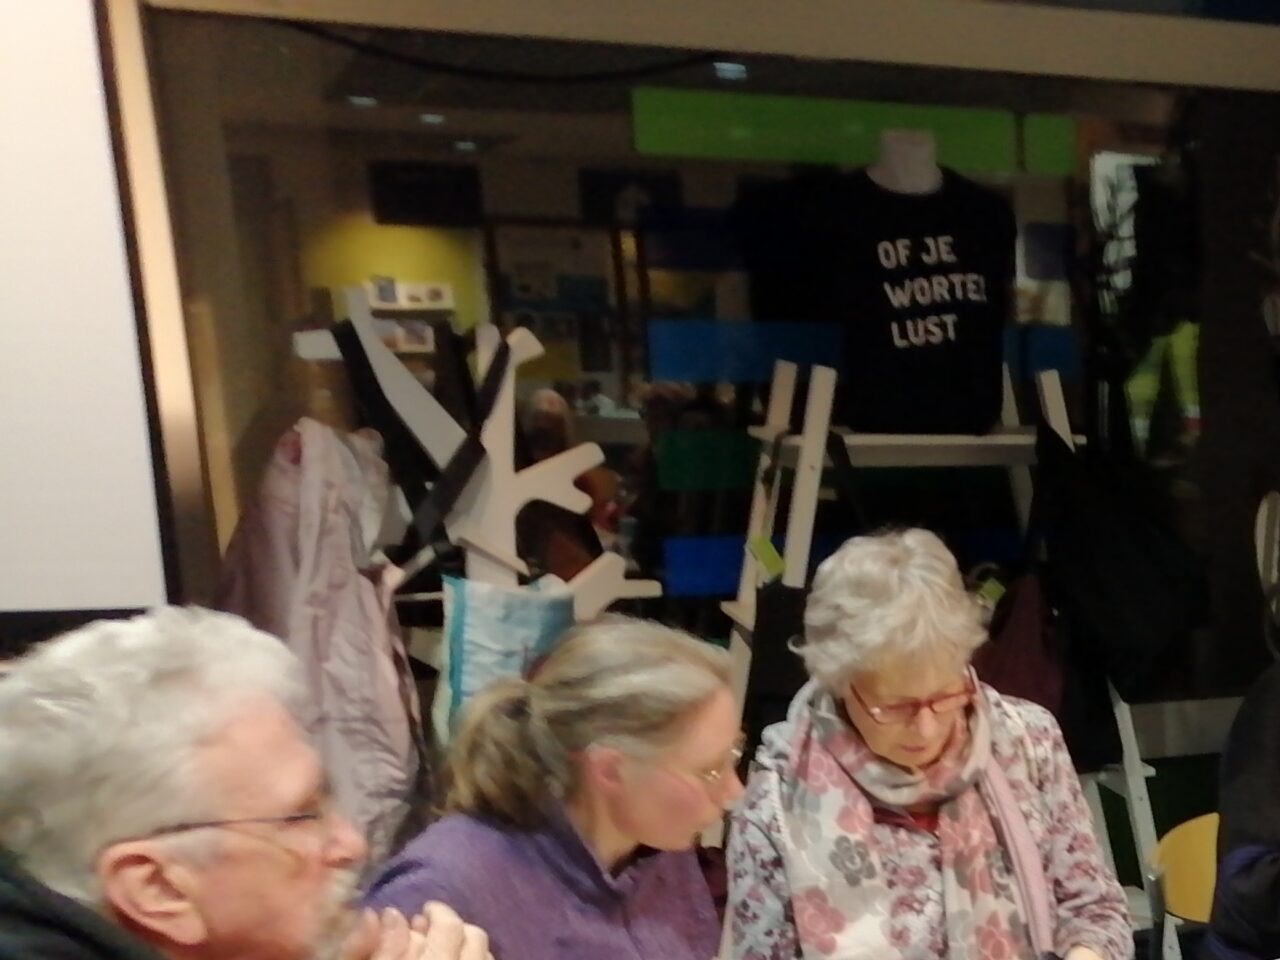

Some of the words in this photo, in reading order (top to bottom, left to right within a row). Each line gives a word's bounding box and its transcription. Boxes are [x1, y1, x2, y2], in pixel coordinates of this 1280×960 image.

[878, 239, 911, 269] OF
[921, 236, 957, 264] JE
[891, 314, 958, 348] LUST
